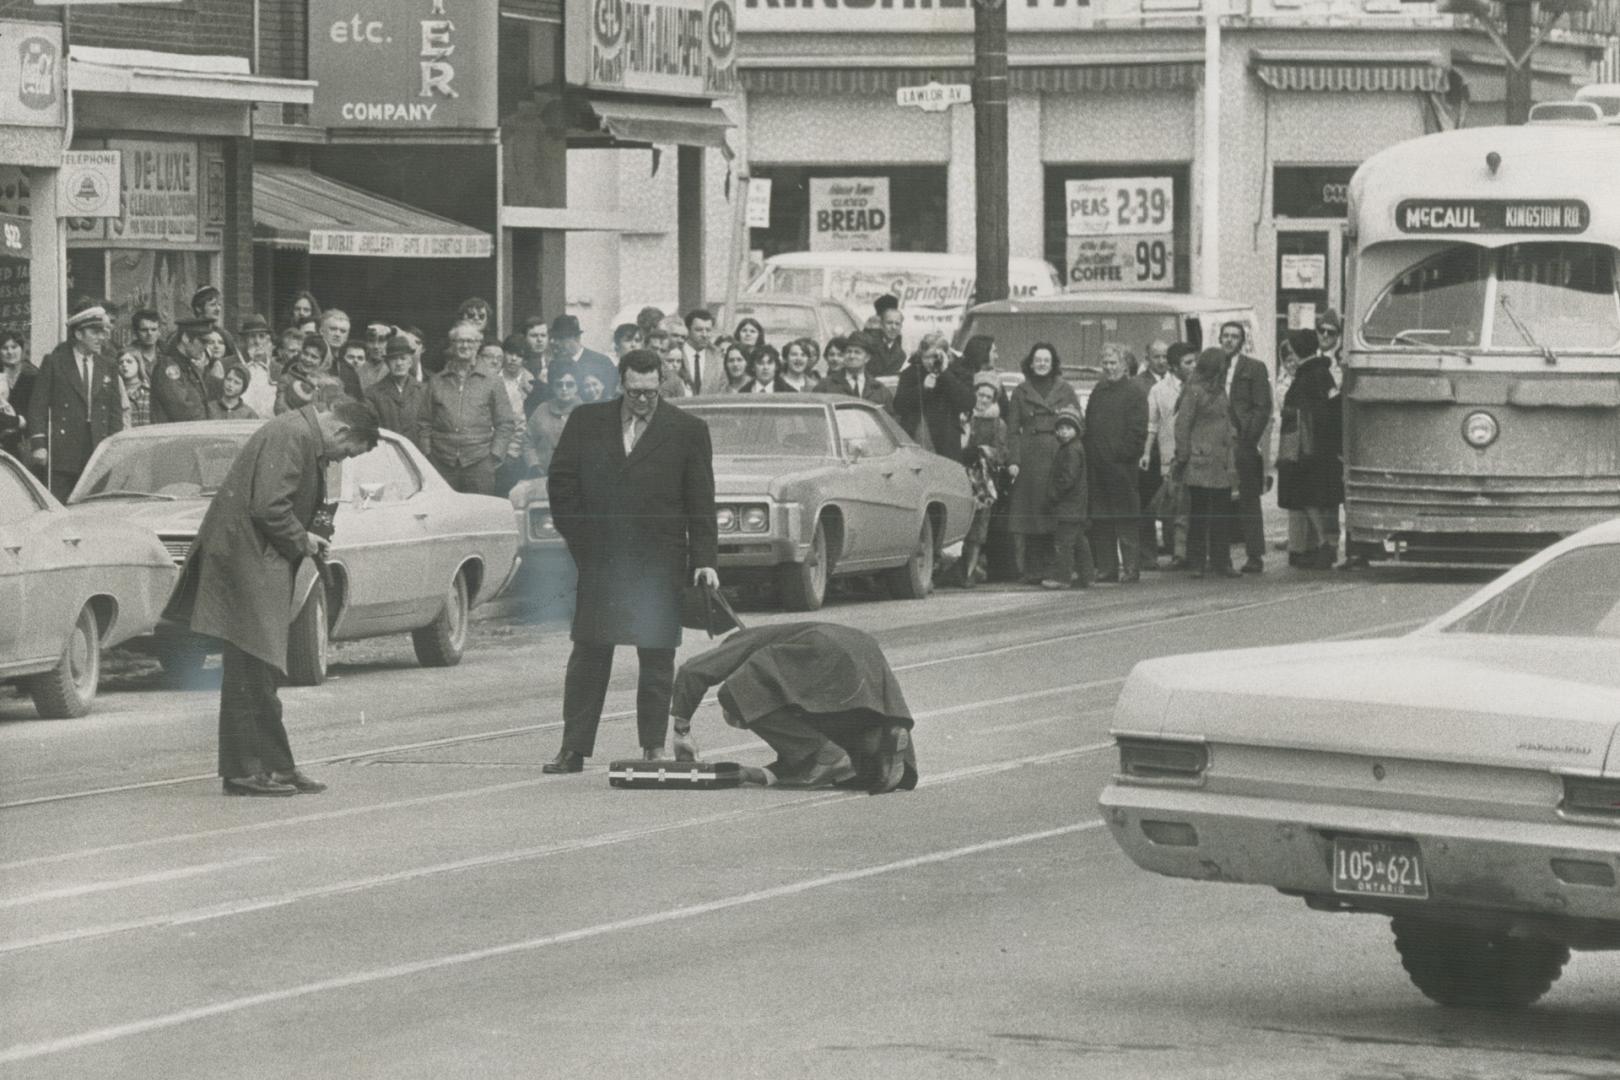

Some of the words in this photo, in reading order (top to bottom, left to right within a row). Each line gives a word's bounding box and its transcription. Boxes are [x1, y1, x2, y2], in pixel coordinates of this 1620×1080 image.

[329, 13, 393, 43] etc.
[903, 88, 943, 103] LAWLOR
[342, 102, 437, 120] COMPANY
[60, 154, 116, 165] TELEPHONE
[1070, 198, 1110, 217] PEAS
[817, 209, 886, 232] BREAD
[1406, 207, 1480, 228] McCAUL
[1505, 206, 1561, 227] KINGSTON
[1070, 266, 1122, 282] COFFEE
[1339, 850, 1374, 881] 105
[1387, 855, 1422, 886] 621
[1358, 881, 1405, 894] ONTARIO
